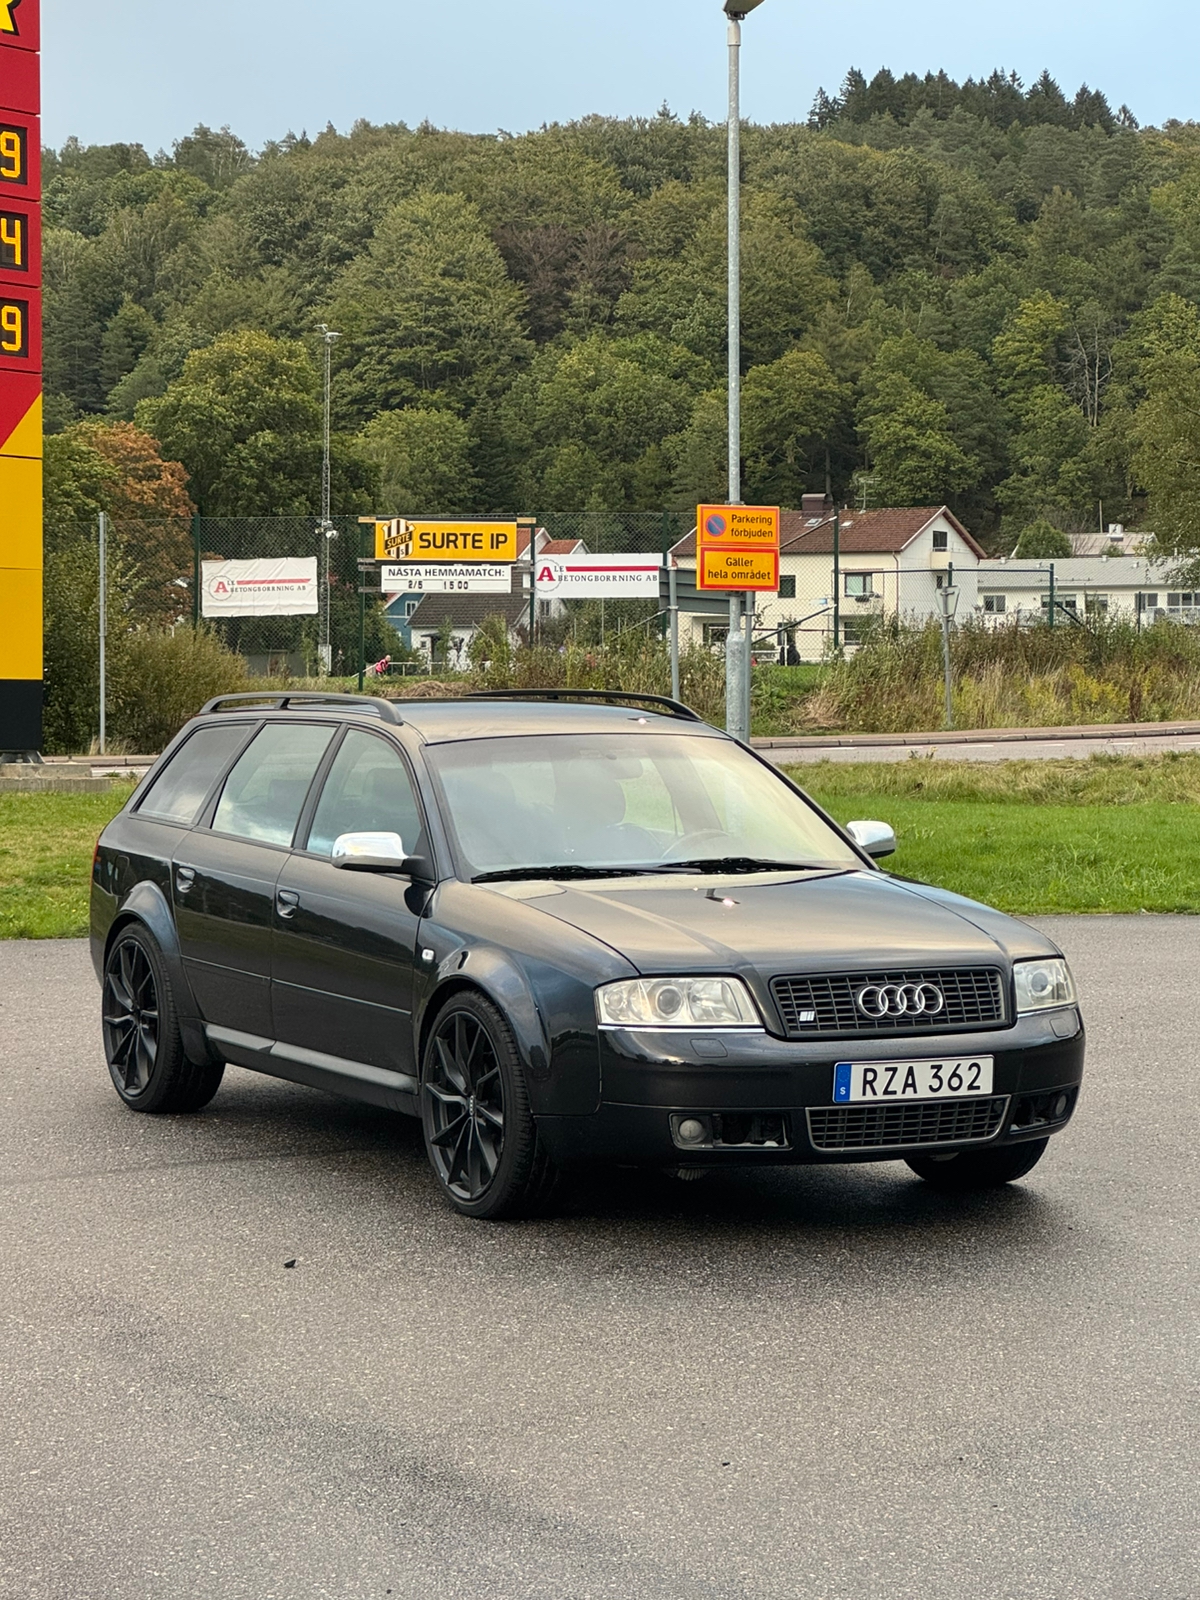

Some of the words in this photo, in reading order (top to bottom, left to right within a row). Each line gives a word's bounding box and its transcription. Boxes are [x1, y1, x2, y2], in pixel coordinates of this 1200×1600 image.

[0, 218, 22, 266] 4
[1, 305, 22, 352] 9
[731, 514, 773, 526] Parkering
[731, 528, 773, 539] förbjuden
[387, 532, 410, 548] SURTE
[419, 532, 483, 550] SURTE
[490, 533, 508, 550] IP
[725, 557, 754, 567] Gäller
[388, 567, 422, 577] NÄSTA
[425, 568, 505, 577] HEMMAMATCH:
[707, 569, 728, 579] hela
[731, 569, 771, 580] området
[558, 574, 642, 582] BETONGBORRNING
[646, 574, 658, 582] AB
[230, 585, 295, 593] BETONGBORRNING
[408, 580, 423, 590] 2/5
[861, 1066, 918, 1097] RZA
[928, 1062, 982, 1093] 362
[839, 1086, 846, 1095] S
